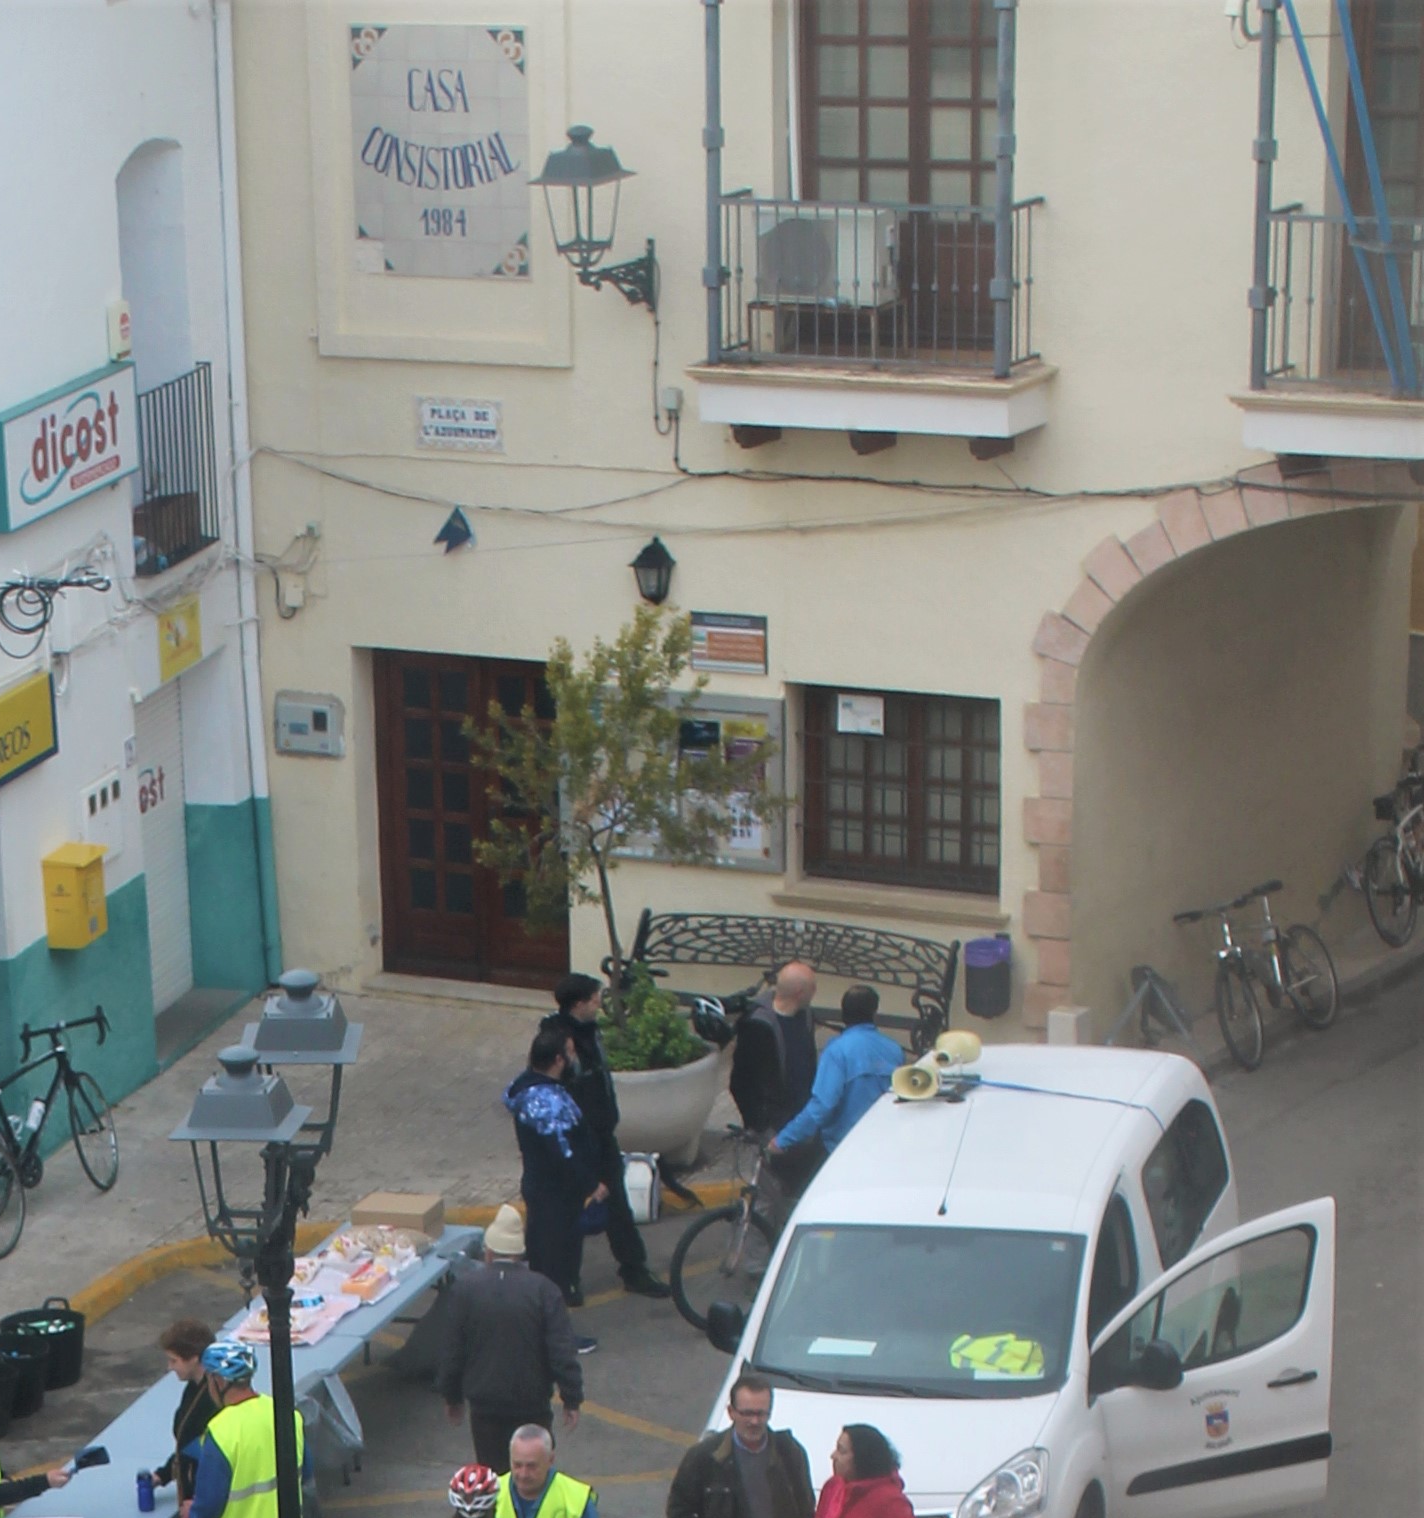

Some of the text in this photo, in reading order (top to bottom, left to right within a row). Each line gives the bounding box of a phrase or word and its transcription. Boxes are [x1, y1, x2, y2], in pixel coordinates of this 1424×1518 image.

[407, 68, 470, 113] CASA
[361, 126, 521, 190] CONSISTORIAL
[419, 208, 467, 237] 1984
[32, 390, 119, 482] dicost
[431, 408, 489, 422] PLAÇA DE
